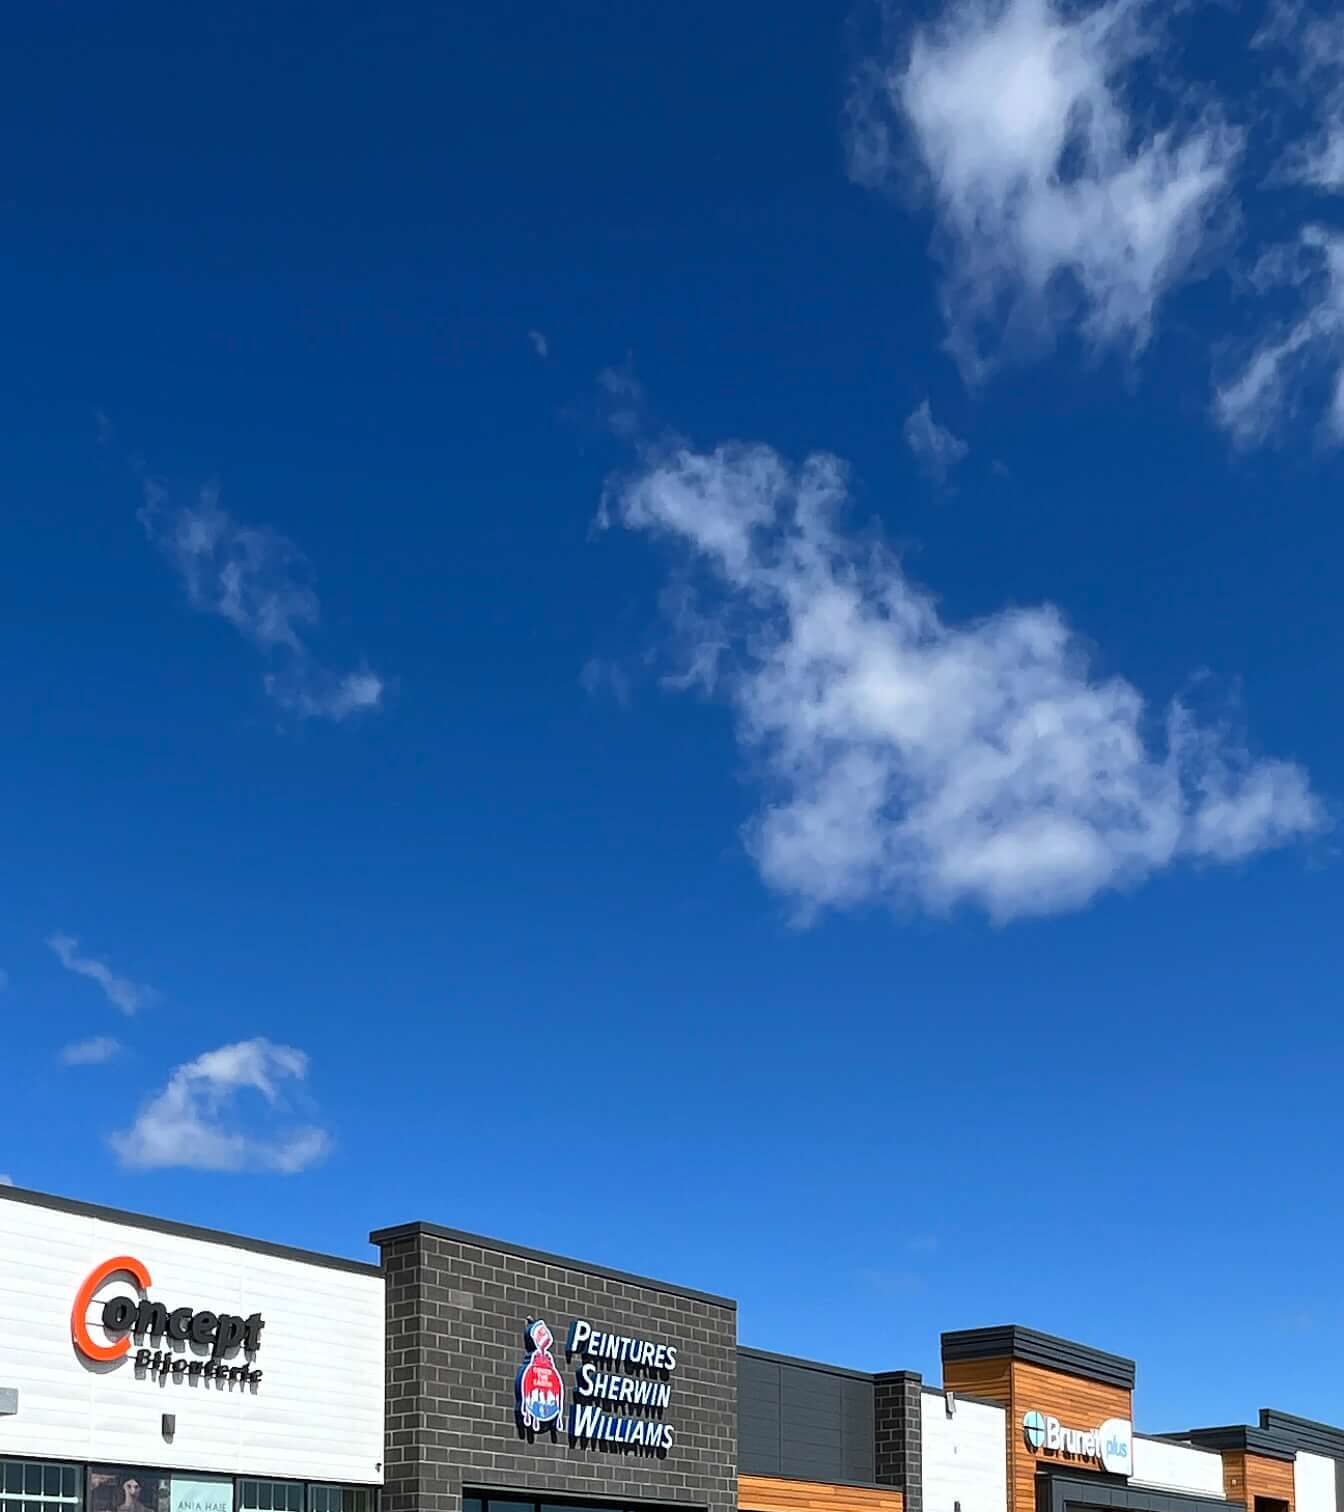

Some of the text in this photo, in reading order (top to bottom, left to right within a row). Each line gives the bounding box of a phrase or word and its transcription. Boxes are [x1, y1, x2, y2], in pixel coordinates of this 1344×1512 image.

[71, 1255, 266, 1363] Concept
[135, 1349, 263, 1383] Bijouterie
[1045, 1416, 1127, 1459] Brunet plus
